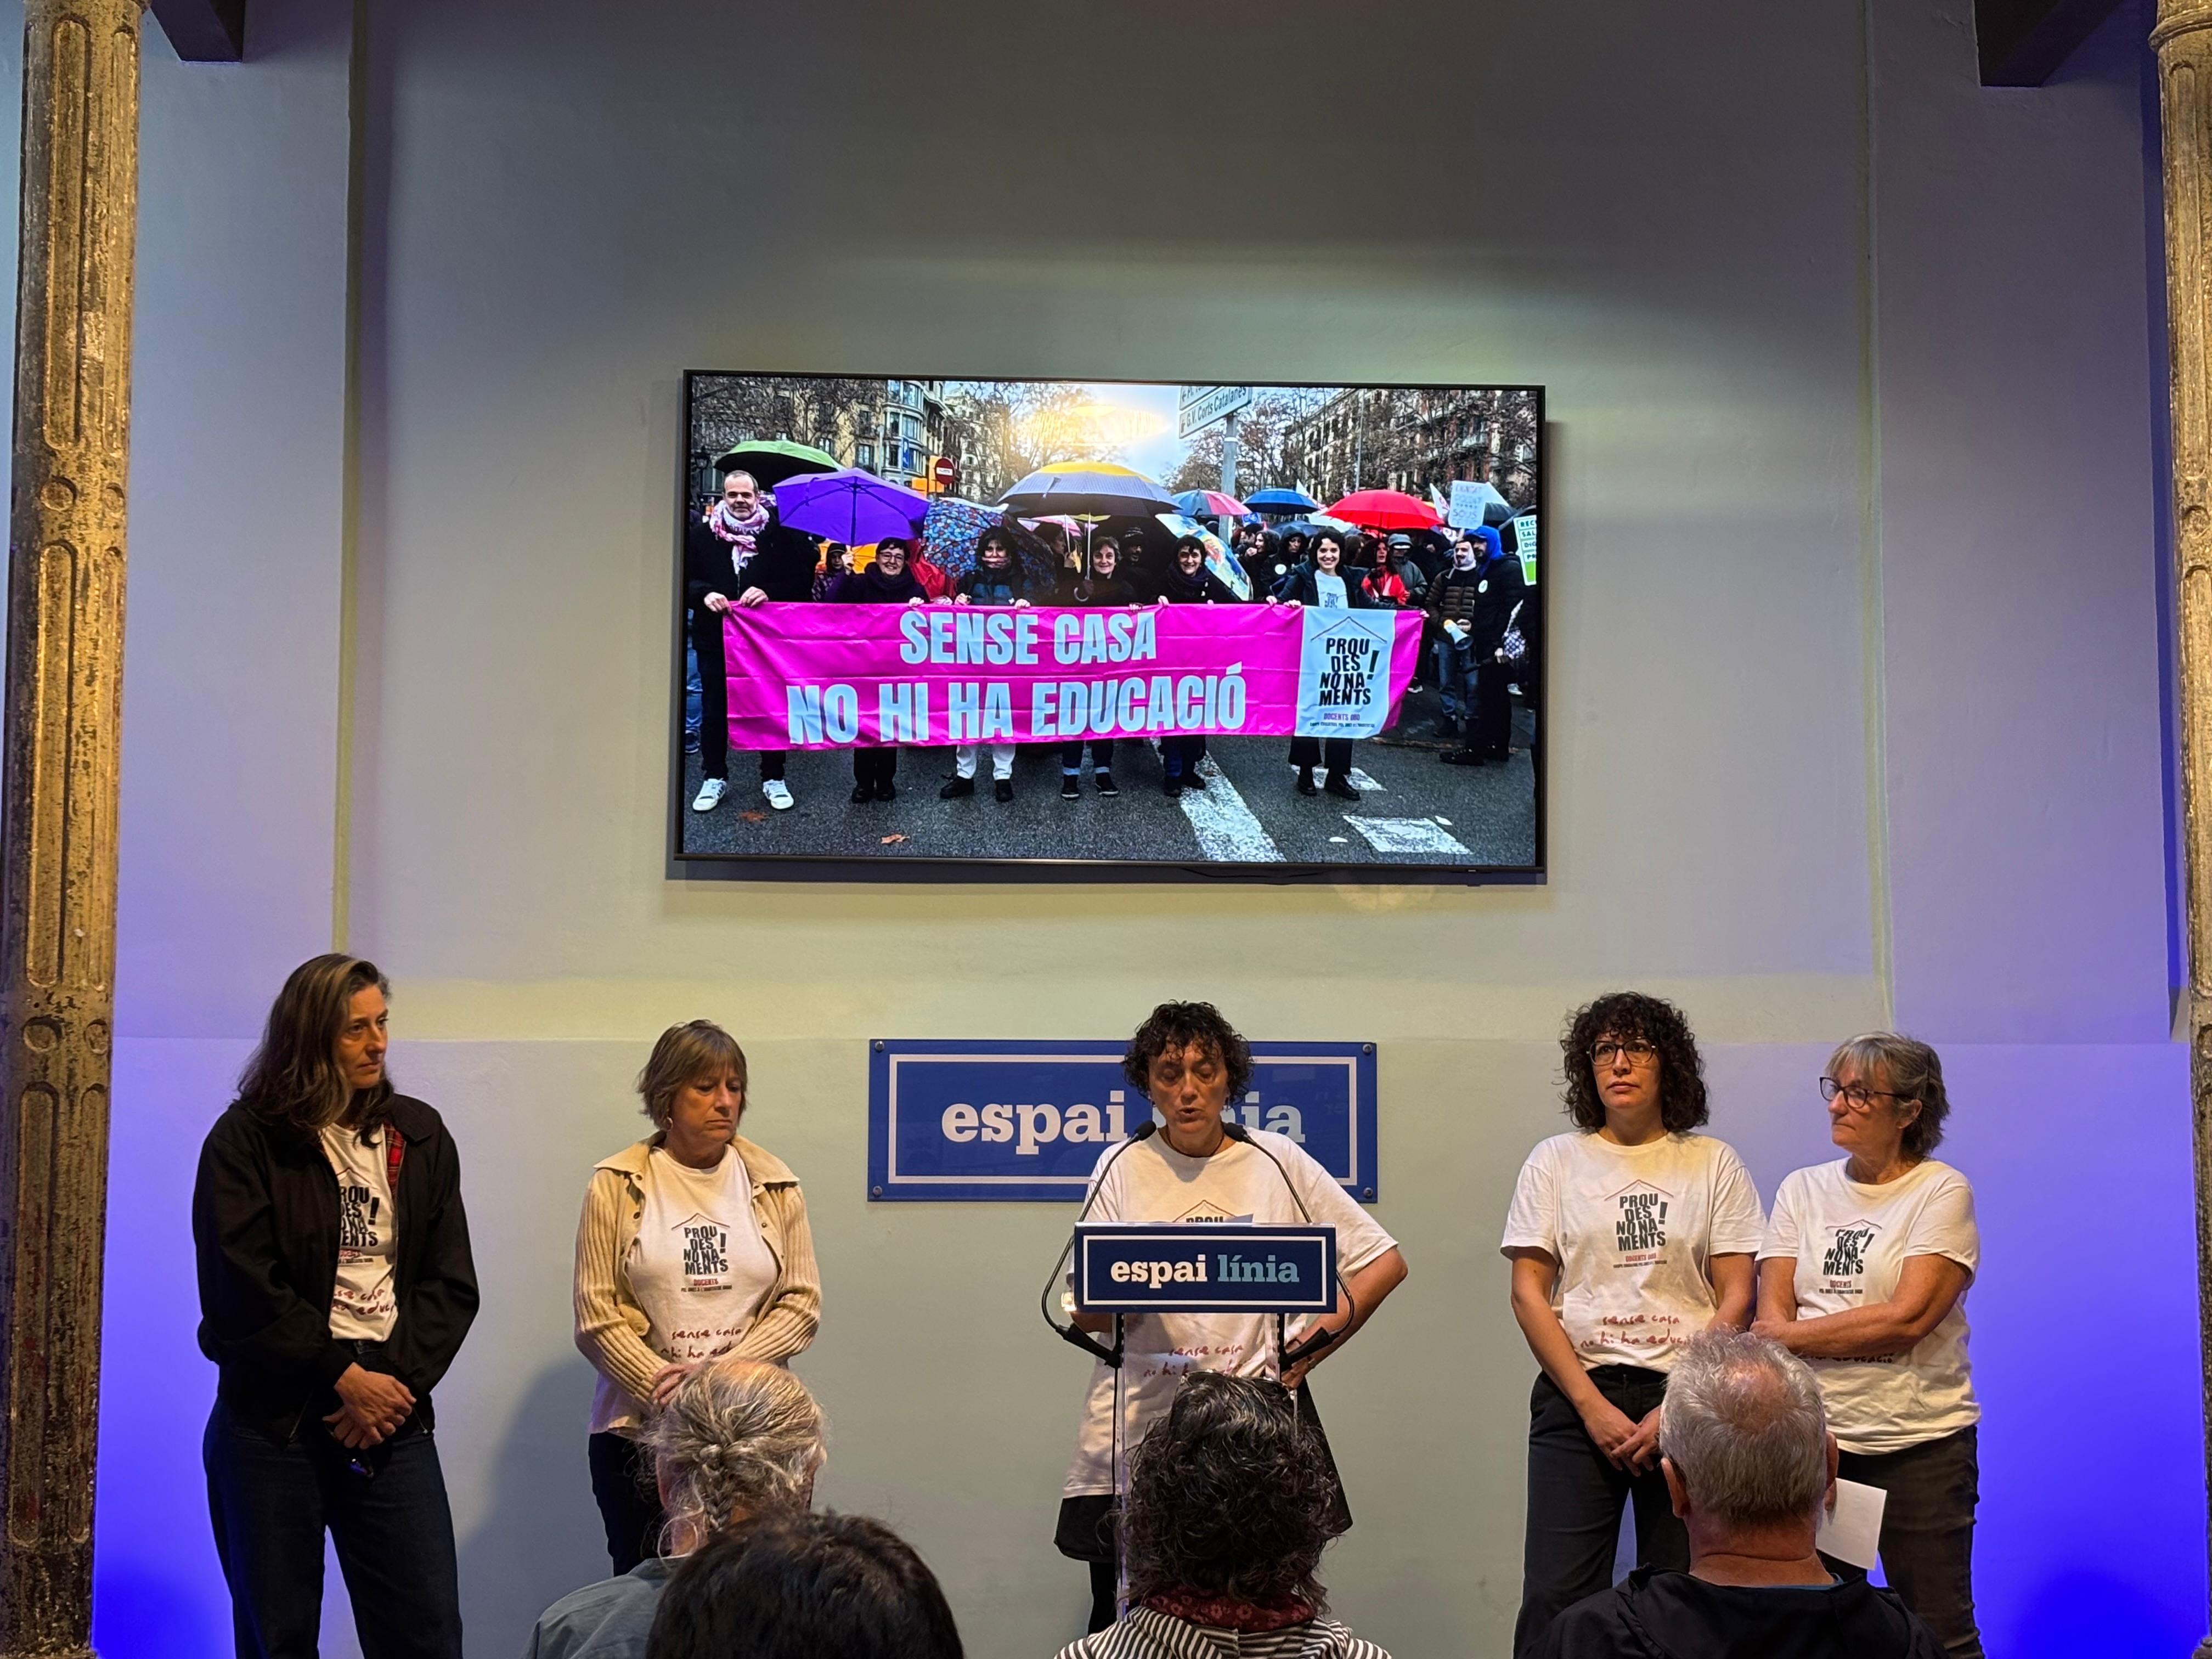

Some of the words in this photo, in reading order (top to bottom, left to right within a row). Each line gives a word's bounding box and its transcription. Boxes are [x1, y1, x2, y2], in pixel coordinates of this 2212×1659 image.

[1198, 402, 1214, 421] Corts
[1214, 386, 1246, 412] Catalanes
[900, 611, 1039, 665] SENSE
[1054, 611, 1156, 665] CASA
[1325, 637, 1370, 655] PROU
[1331, 654, 1361, 673] DES
[786, 684, 859, 744] NO
[879, 682, 929, 742] HI
[948, 682, 1014, 740] HA
[1031, 661, 1246, 736] EDUCACIÓ
[1318, 688, 1371, 707] MENTS
[1324, 713, 1348, 721] DOCENTS
[941, 1090, 1128, 1155] espai
[340, 1186, 370, 1204] ROU
[1620, 1193, 1658, 1209] PROU
[1624, 1205, 1652, 1222] DES
[341, 1231, 379, 1247] ENTS
[684, 1225, 718, 1239] PROU
[690, 1237, 714, 1251] DES
[1618, 1231, 1666, 1251] MENTS
[685, 1259, 729, 1276] MENTS
[1110, 1254, 1207, 1289] espai
[1217, 1254, 1300, 1283] línia
[1823, 1259, 1864, 1276] MENTS
[1602, 1314, 1645, 1325] sense
[1651, 1314, 1679, 1324] casa
[672, 1329, 711, 1340] sense
[715, 1327, 742, 1336] casa
[1621, 1331, 1640, 1344] ha
[687, 1346, 704, 1358] ha
[1169, 1346, 1209, 1356] sense
[1215, 1345, 1243, 1355] casa
